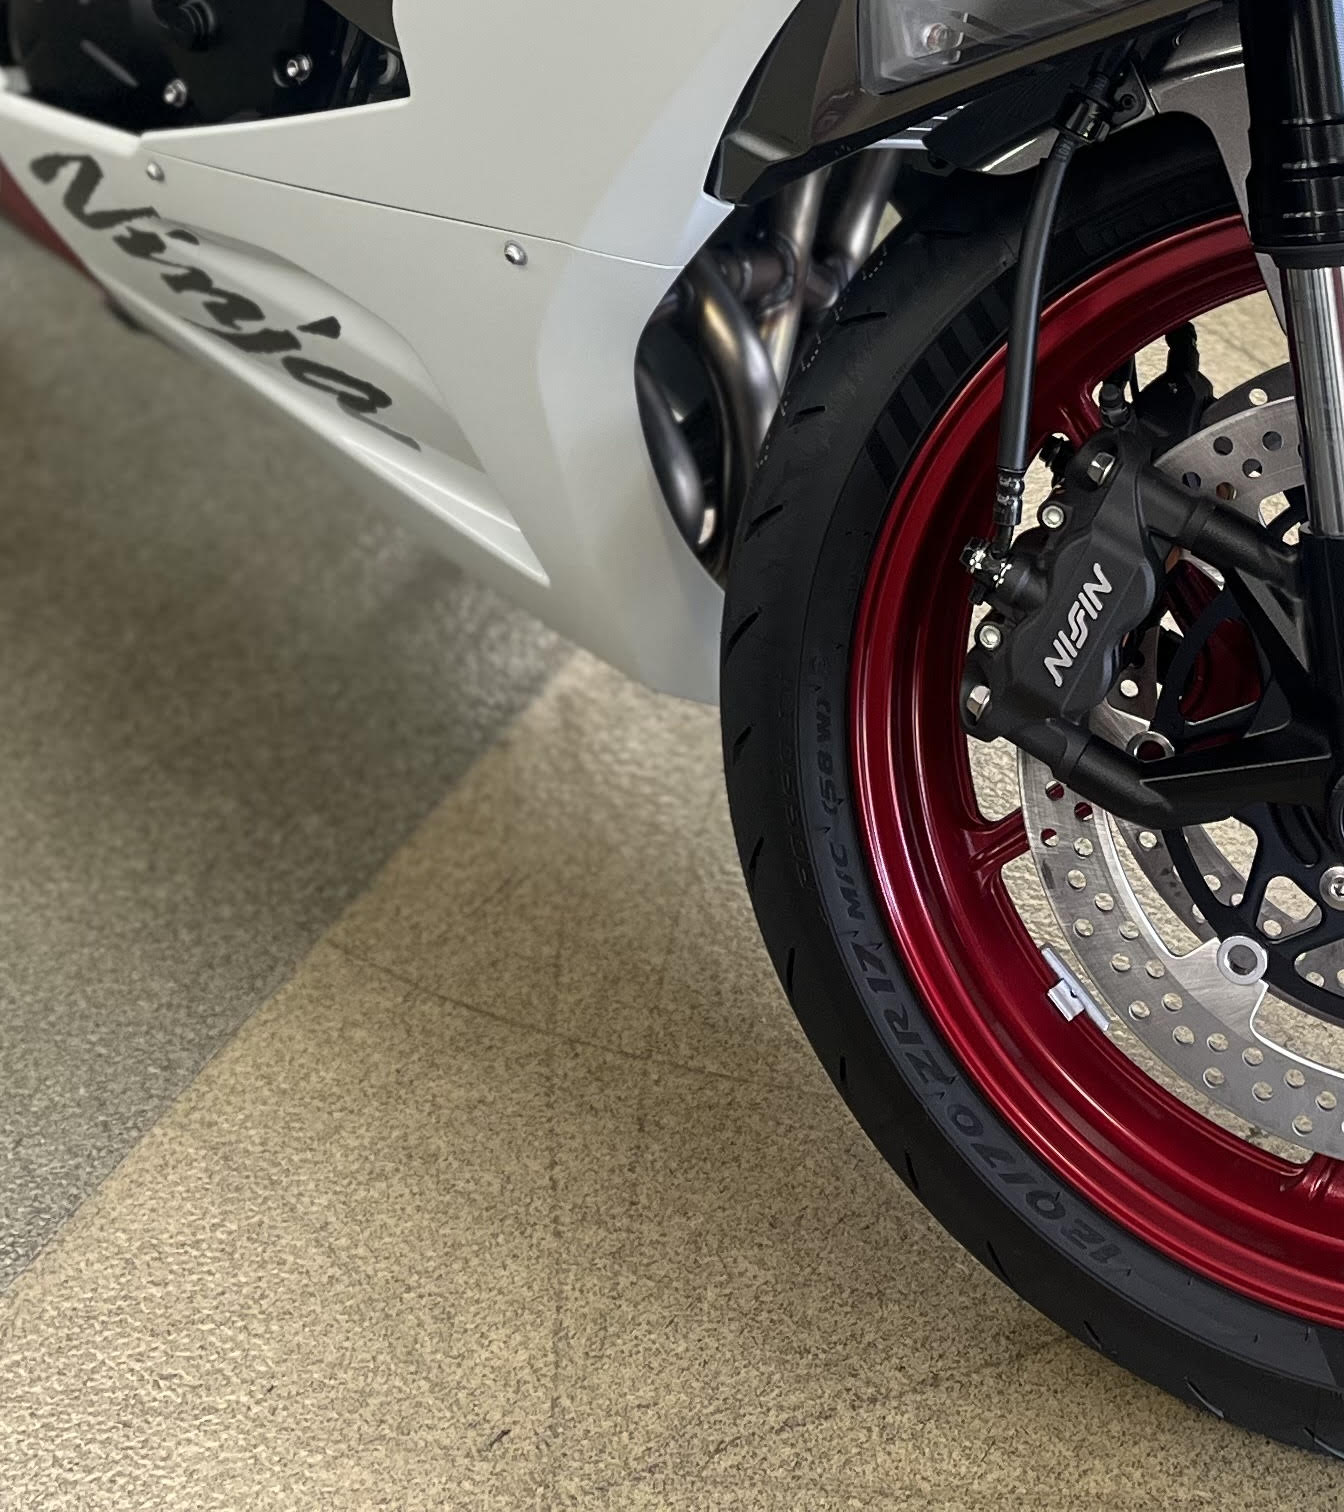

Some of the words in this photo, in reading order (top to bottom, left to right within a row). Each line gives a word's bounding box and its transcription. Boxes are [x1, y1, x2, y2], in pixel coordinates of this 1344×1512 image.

[30, 153, 421, 452] Ninja
[1044, 562, 1112, 687] NISSIN
[946, 1103, 1121, 1268] 120/70
